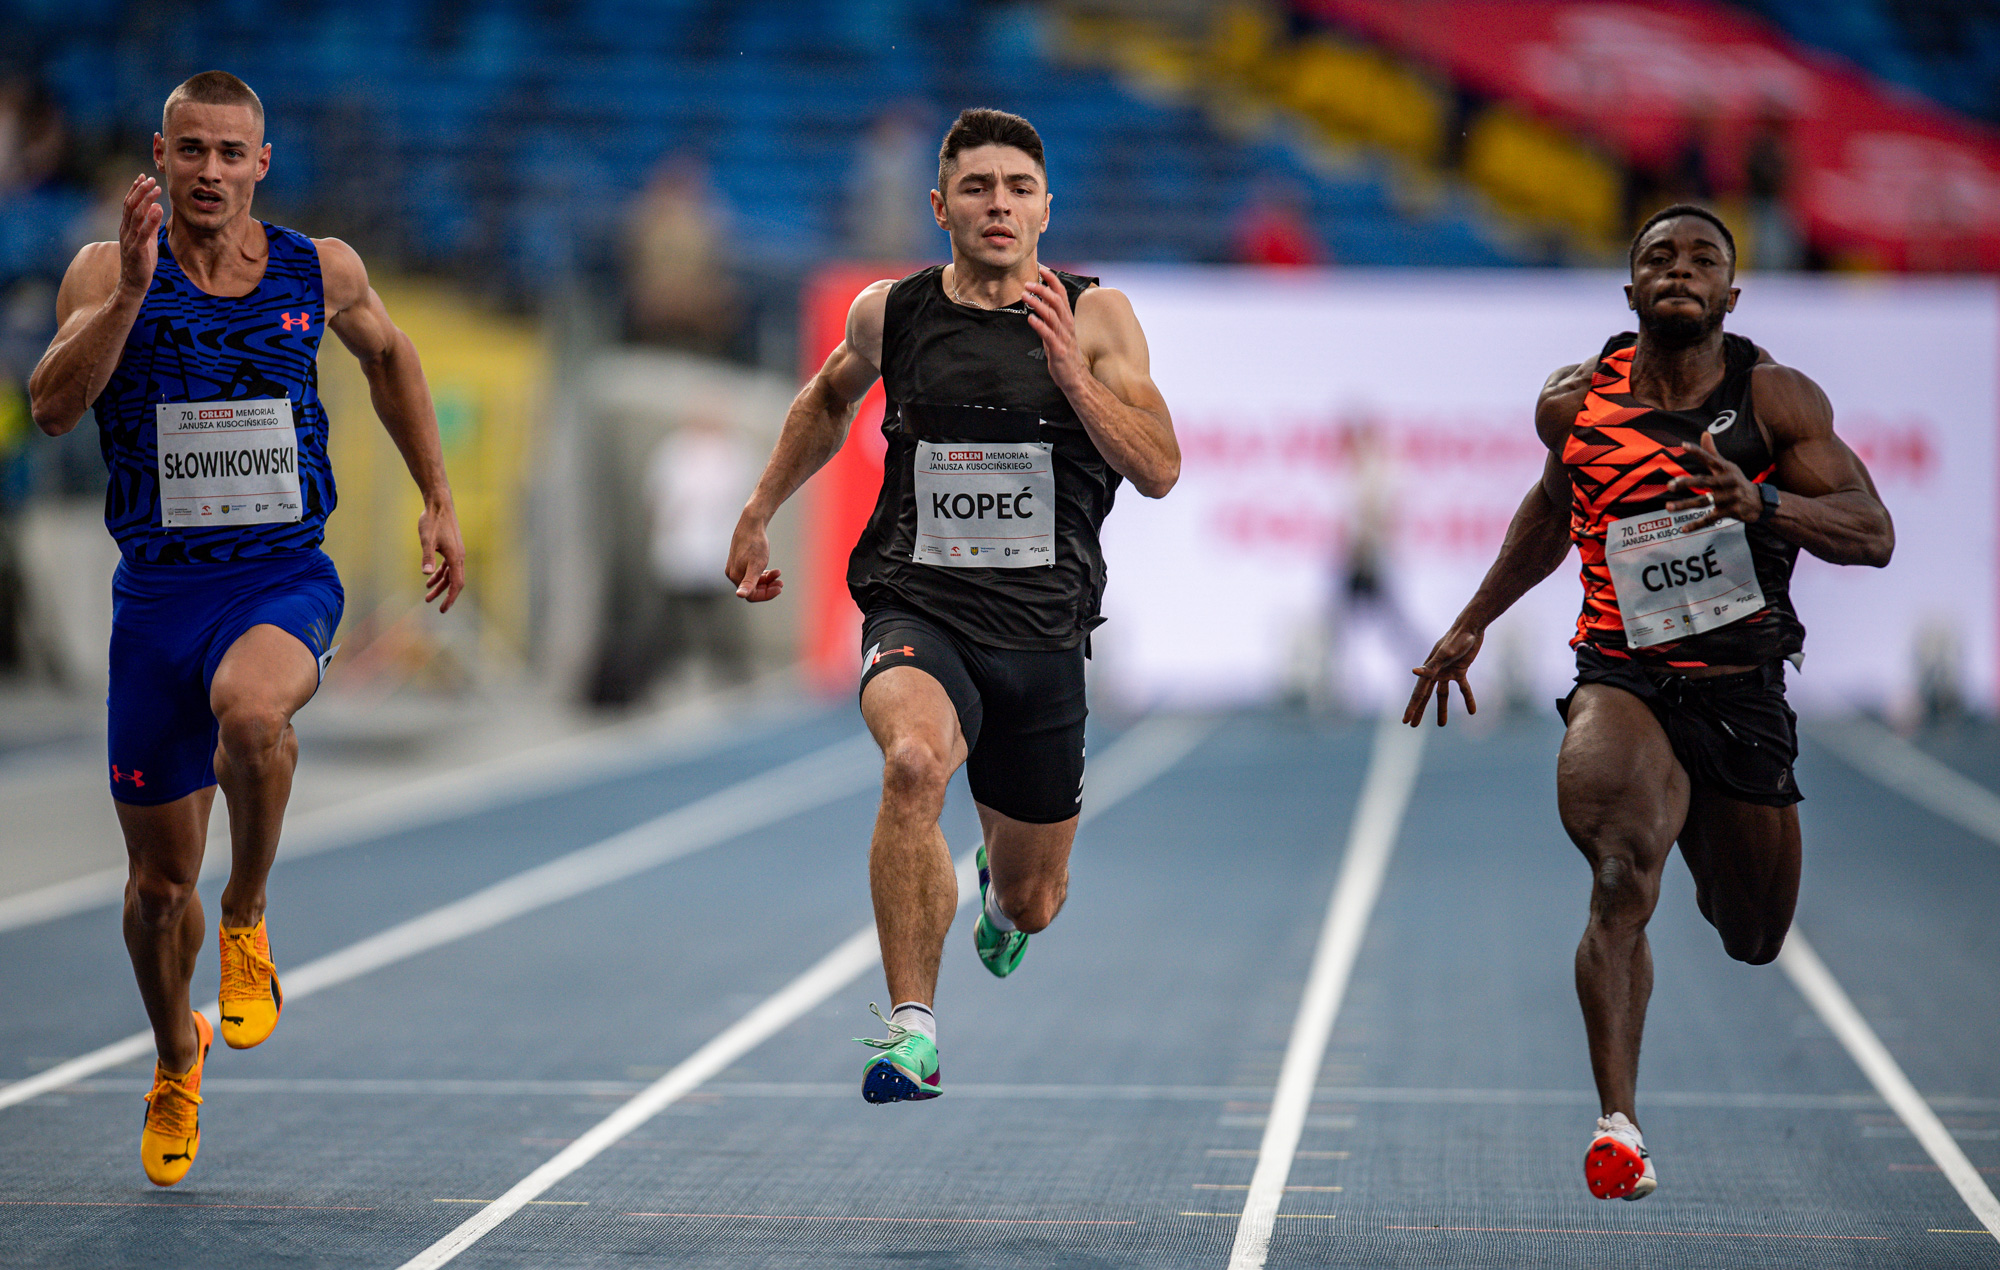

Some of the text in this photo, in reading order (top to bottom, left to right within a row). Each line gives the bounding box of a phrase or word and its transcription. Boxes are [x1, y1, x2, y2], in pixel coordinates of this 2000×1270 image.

[181, 408, 275, 421] 70. ORLEN MEMORIAŁ
[178, 417, 279, 430] JANUSZA KUSOCIŃSKIEGO
[164, 447, 294, 480] SŁOWIKOWSKI
[931, 452, 1029, 462] 70. ORLEN MEMORIAŁ
[929, 461, 1033, 471] JANUSZA KUSOCIŃSKIEGO
[932, 486, 1034, 519] KOPEĆ
[1621, 526, 1637, 537] 70.
[1640, 518, 1670, 532] ORLEN
[1622, 533, 1655, 547] JANUSZA
[1642, 544, 1722, 592] CISSÉ
